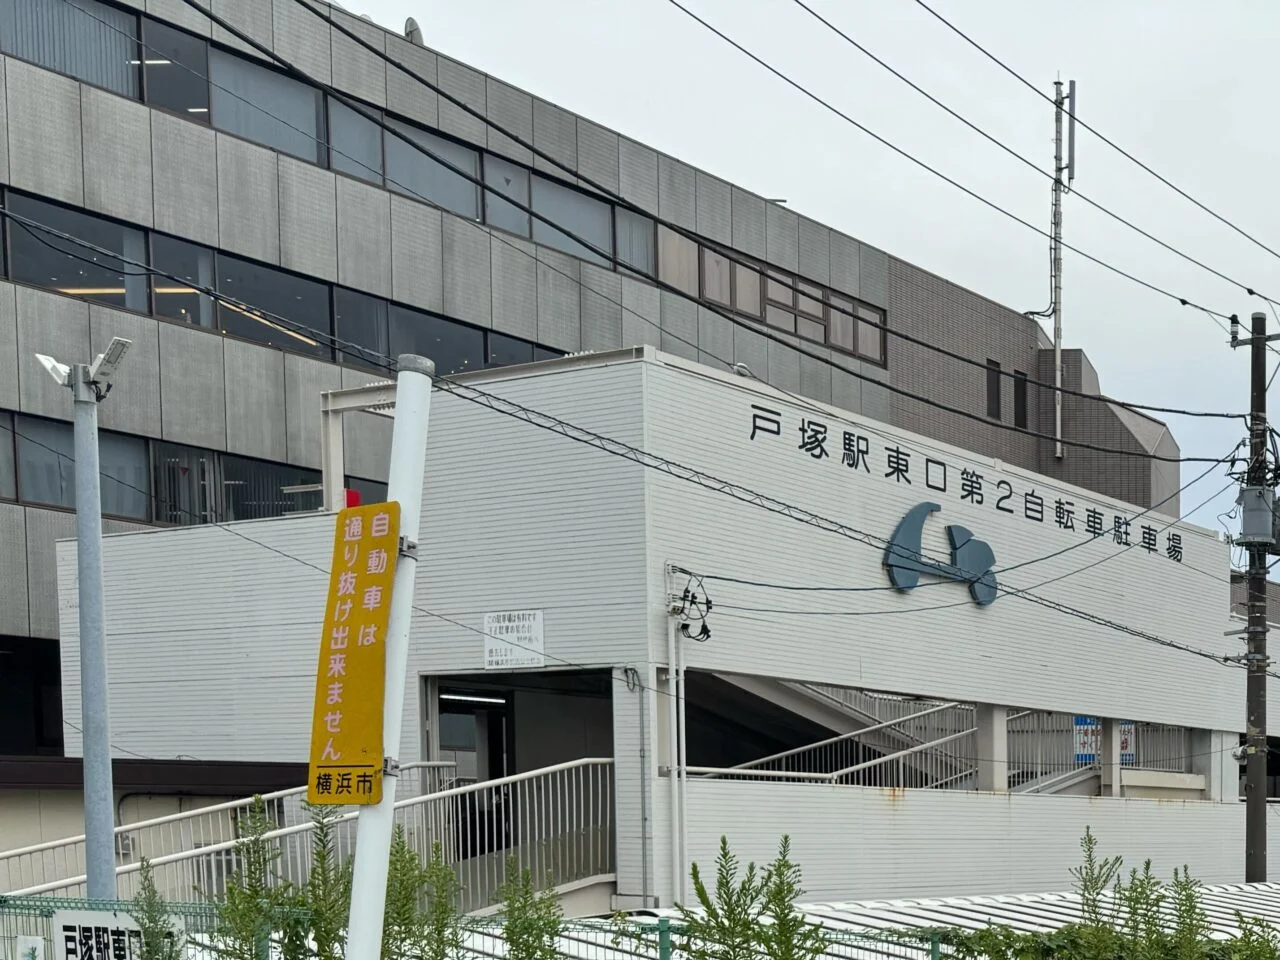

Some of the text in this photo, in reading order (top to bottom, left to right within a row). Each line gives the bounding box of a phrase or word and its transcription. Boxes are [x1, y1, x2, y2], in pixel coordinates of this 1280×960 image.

[749, 403, 1184, 564] 戸塚駅東口第2自転車駐車場
[320, 518, 363, 762] 通り抜け出来ません
[358, 512, 390, 648] 自動車は
[316, 772, 375, 796] 横浜市
